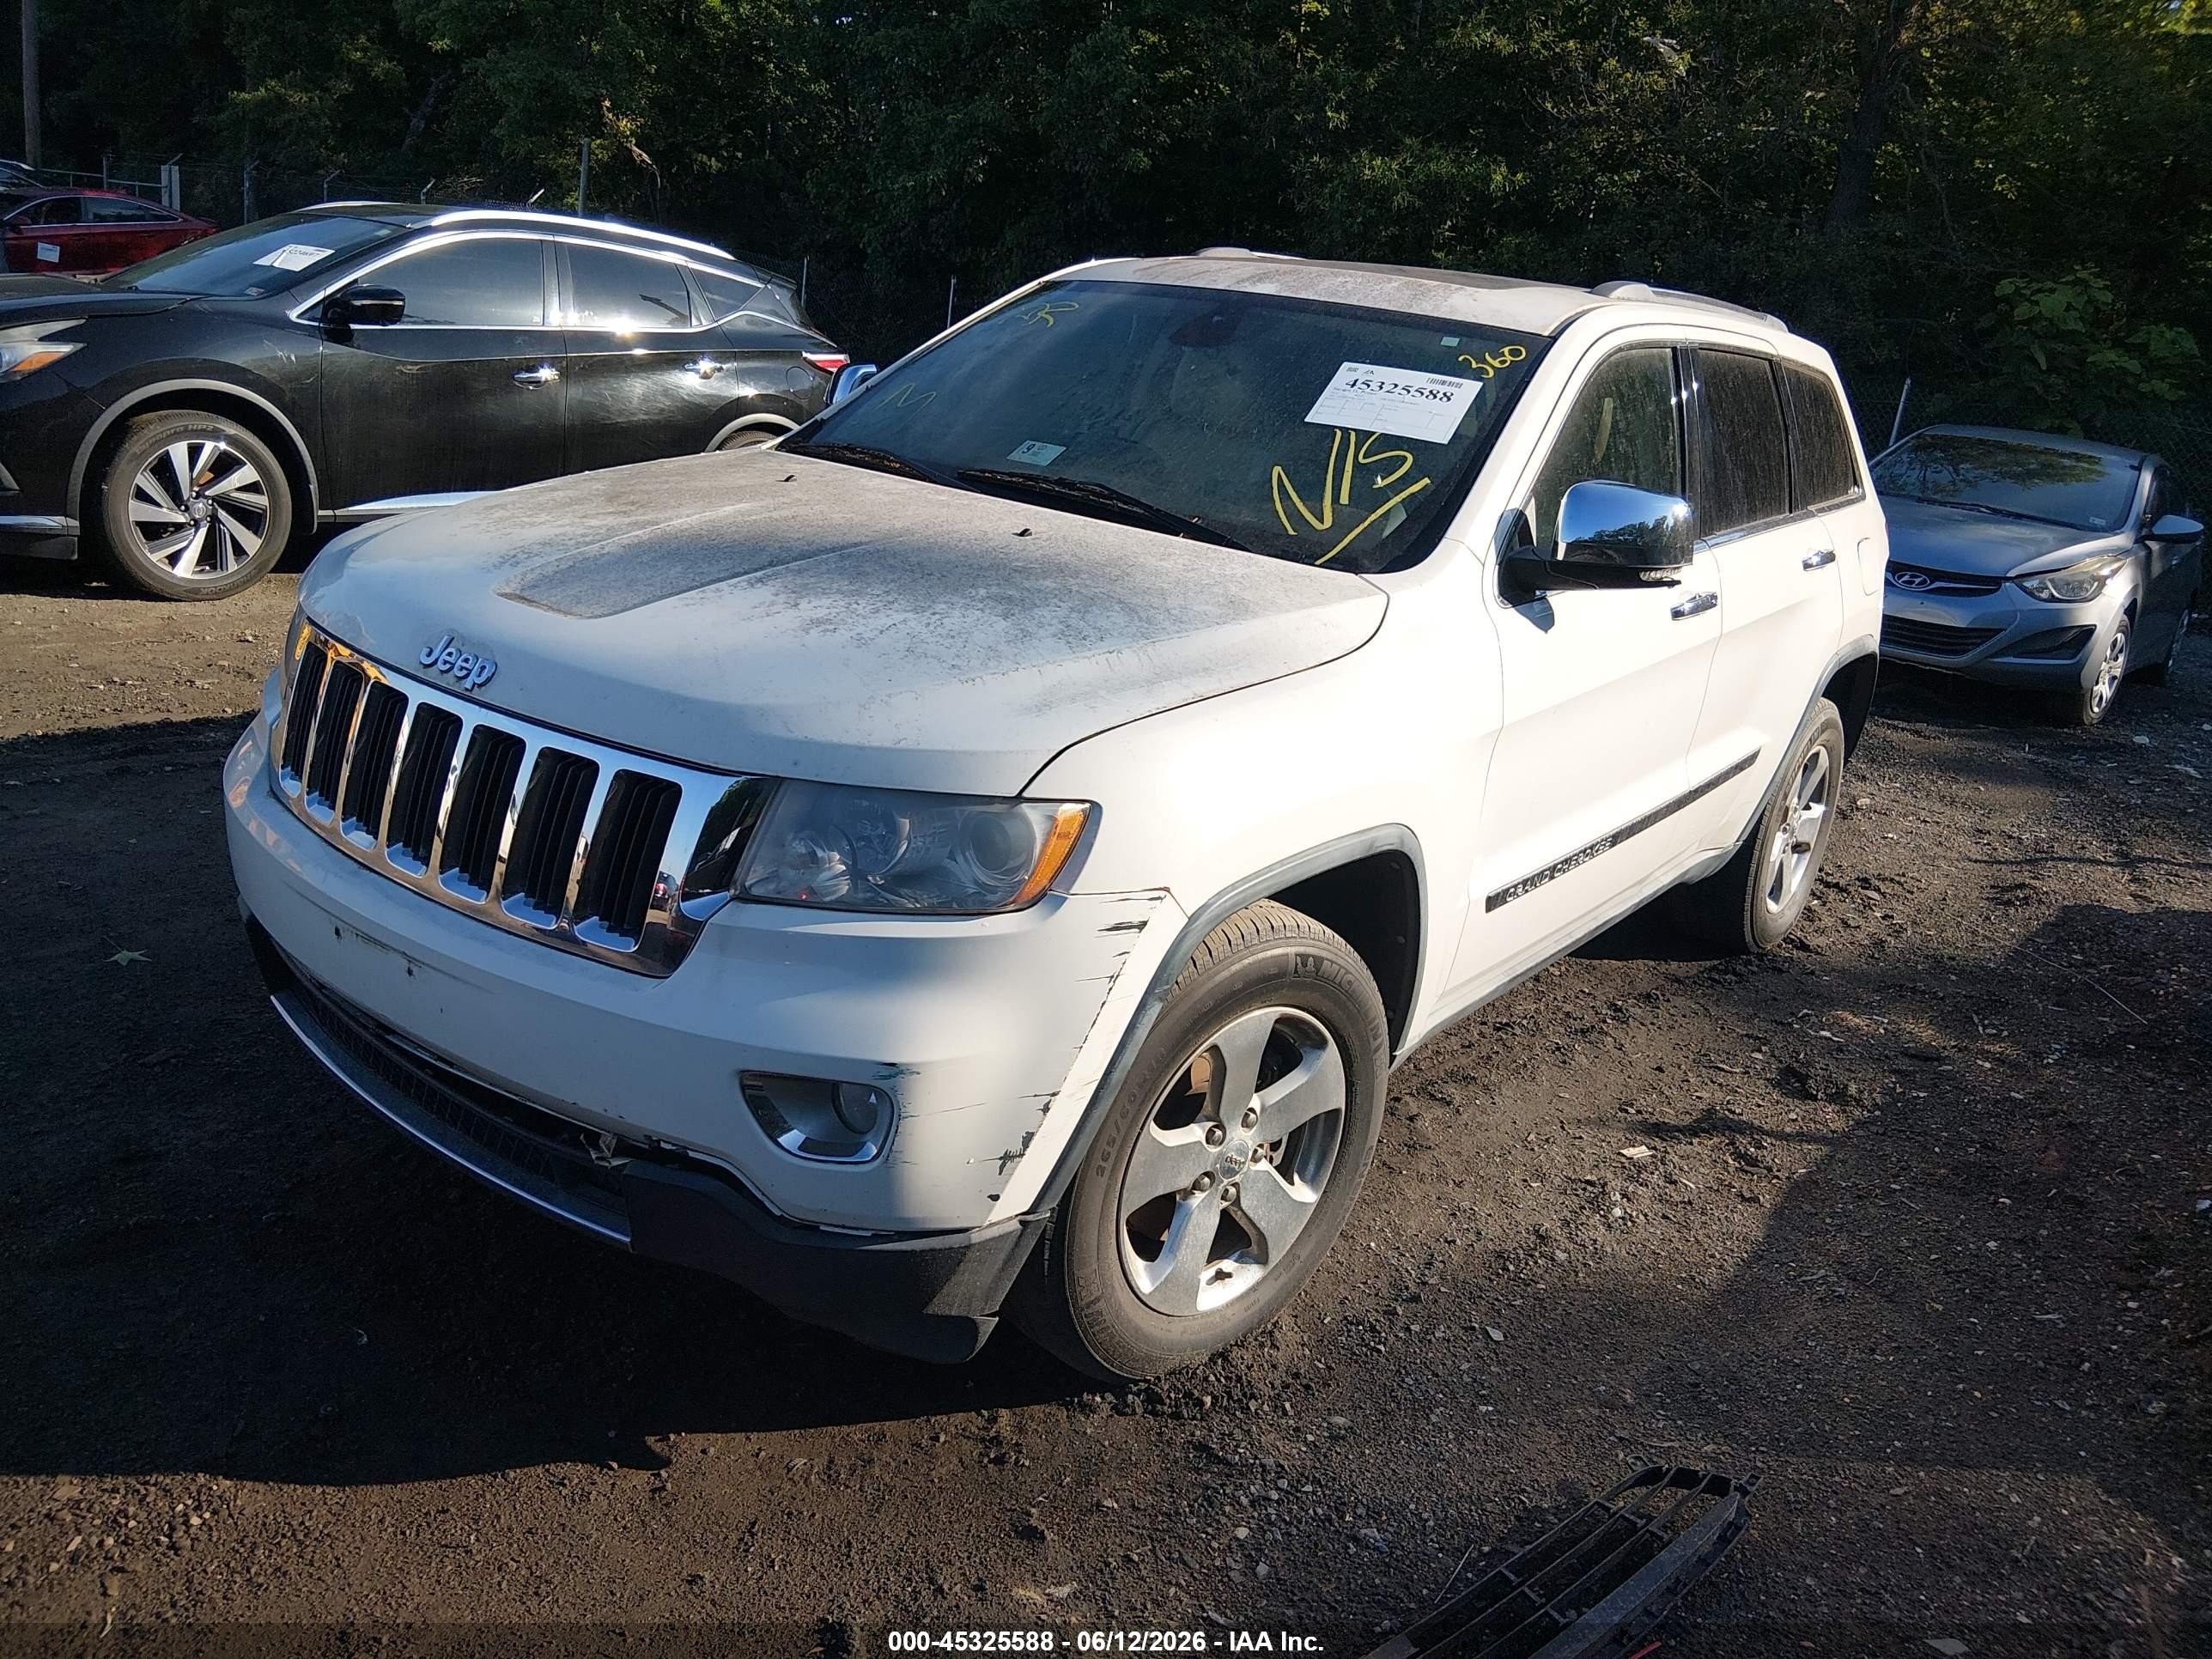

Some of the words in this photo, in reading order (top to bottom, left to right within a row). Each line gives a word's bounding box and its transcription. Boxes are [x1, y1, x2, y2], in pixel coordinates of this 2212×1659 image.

[1457, 345, 1526, 378] 360
[1345, 377, 1455, 404] 45325588
[419, 635, 498, 691] Jeep
[1505, 870, 1552, 902] GRAND
[1553, 836, 1613, 878] CHEROKEE
